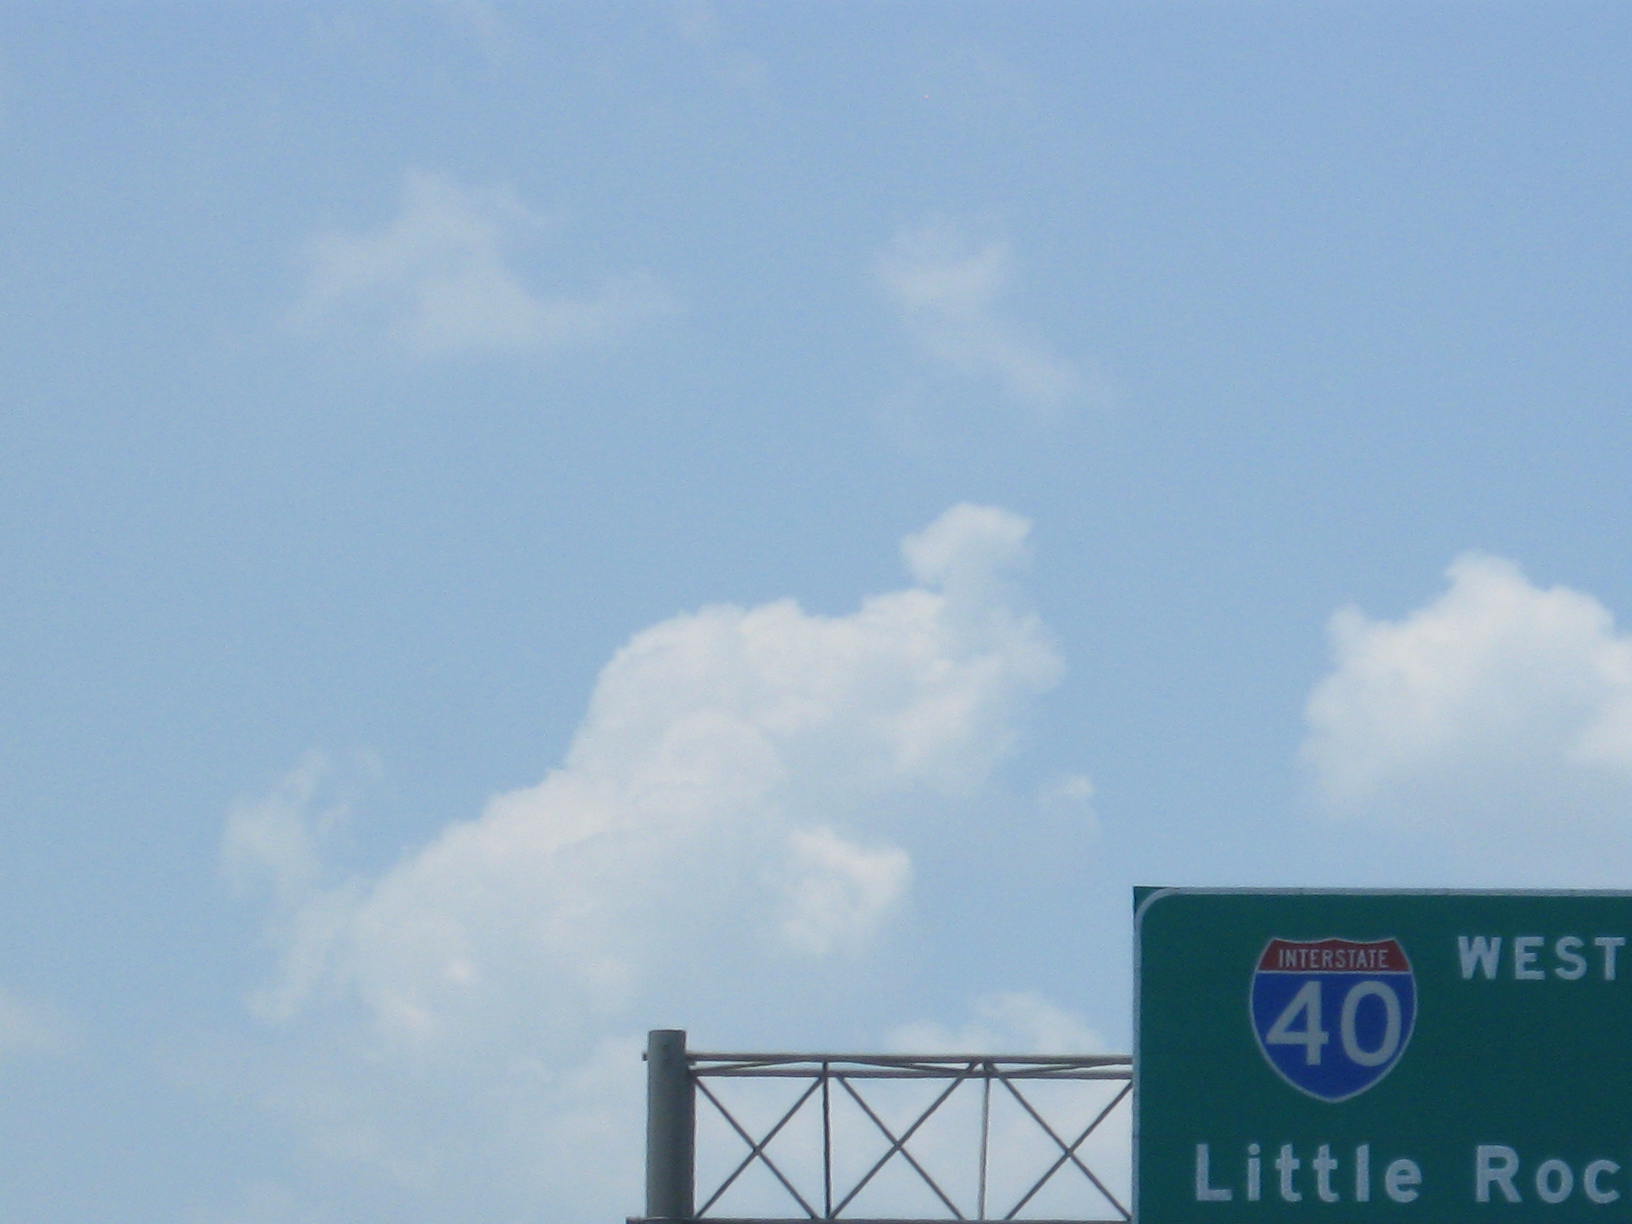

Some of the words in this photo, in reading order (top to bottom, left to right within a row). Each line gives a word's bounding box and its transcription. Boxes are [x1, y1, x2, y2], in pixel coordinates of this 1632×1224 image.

[1278, 948, 1390, 970] INTERSTATE
[1457, 935, 1626, 981] WEST
[1266, 980, 1400, 1066] 40
[1195, 1143, 1422, 1203] Little
